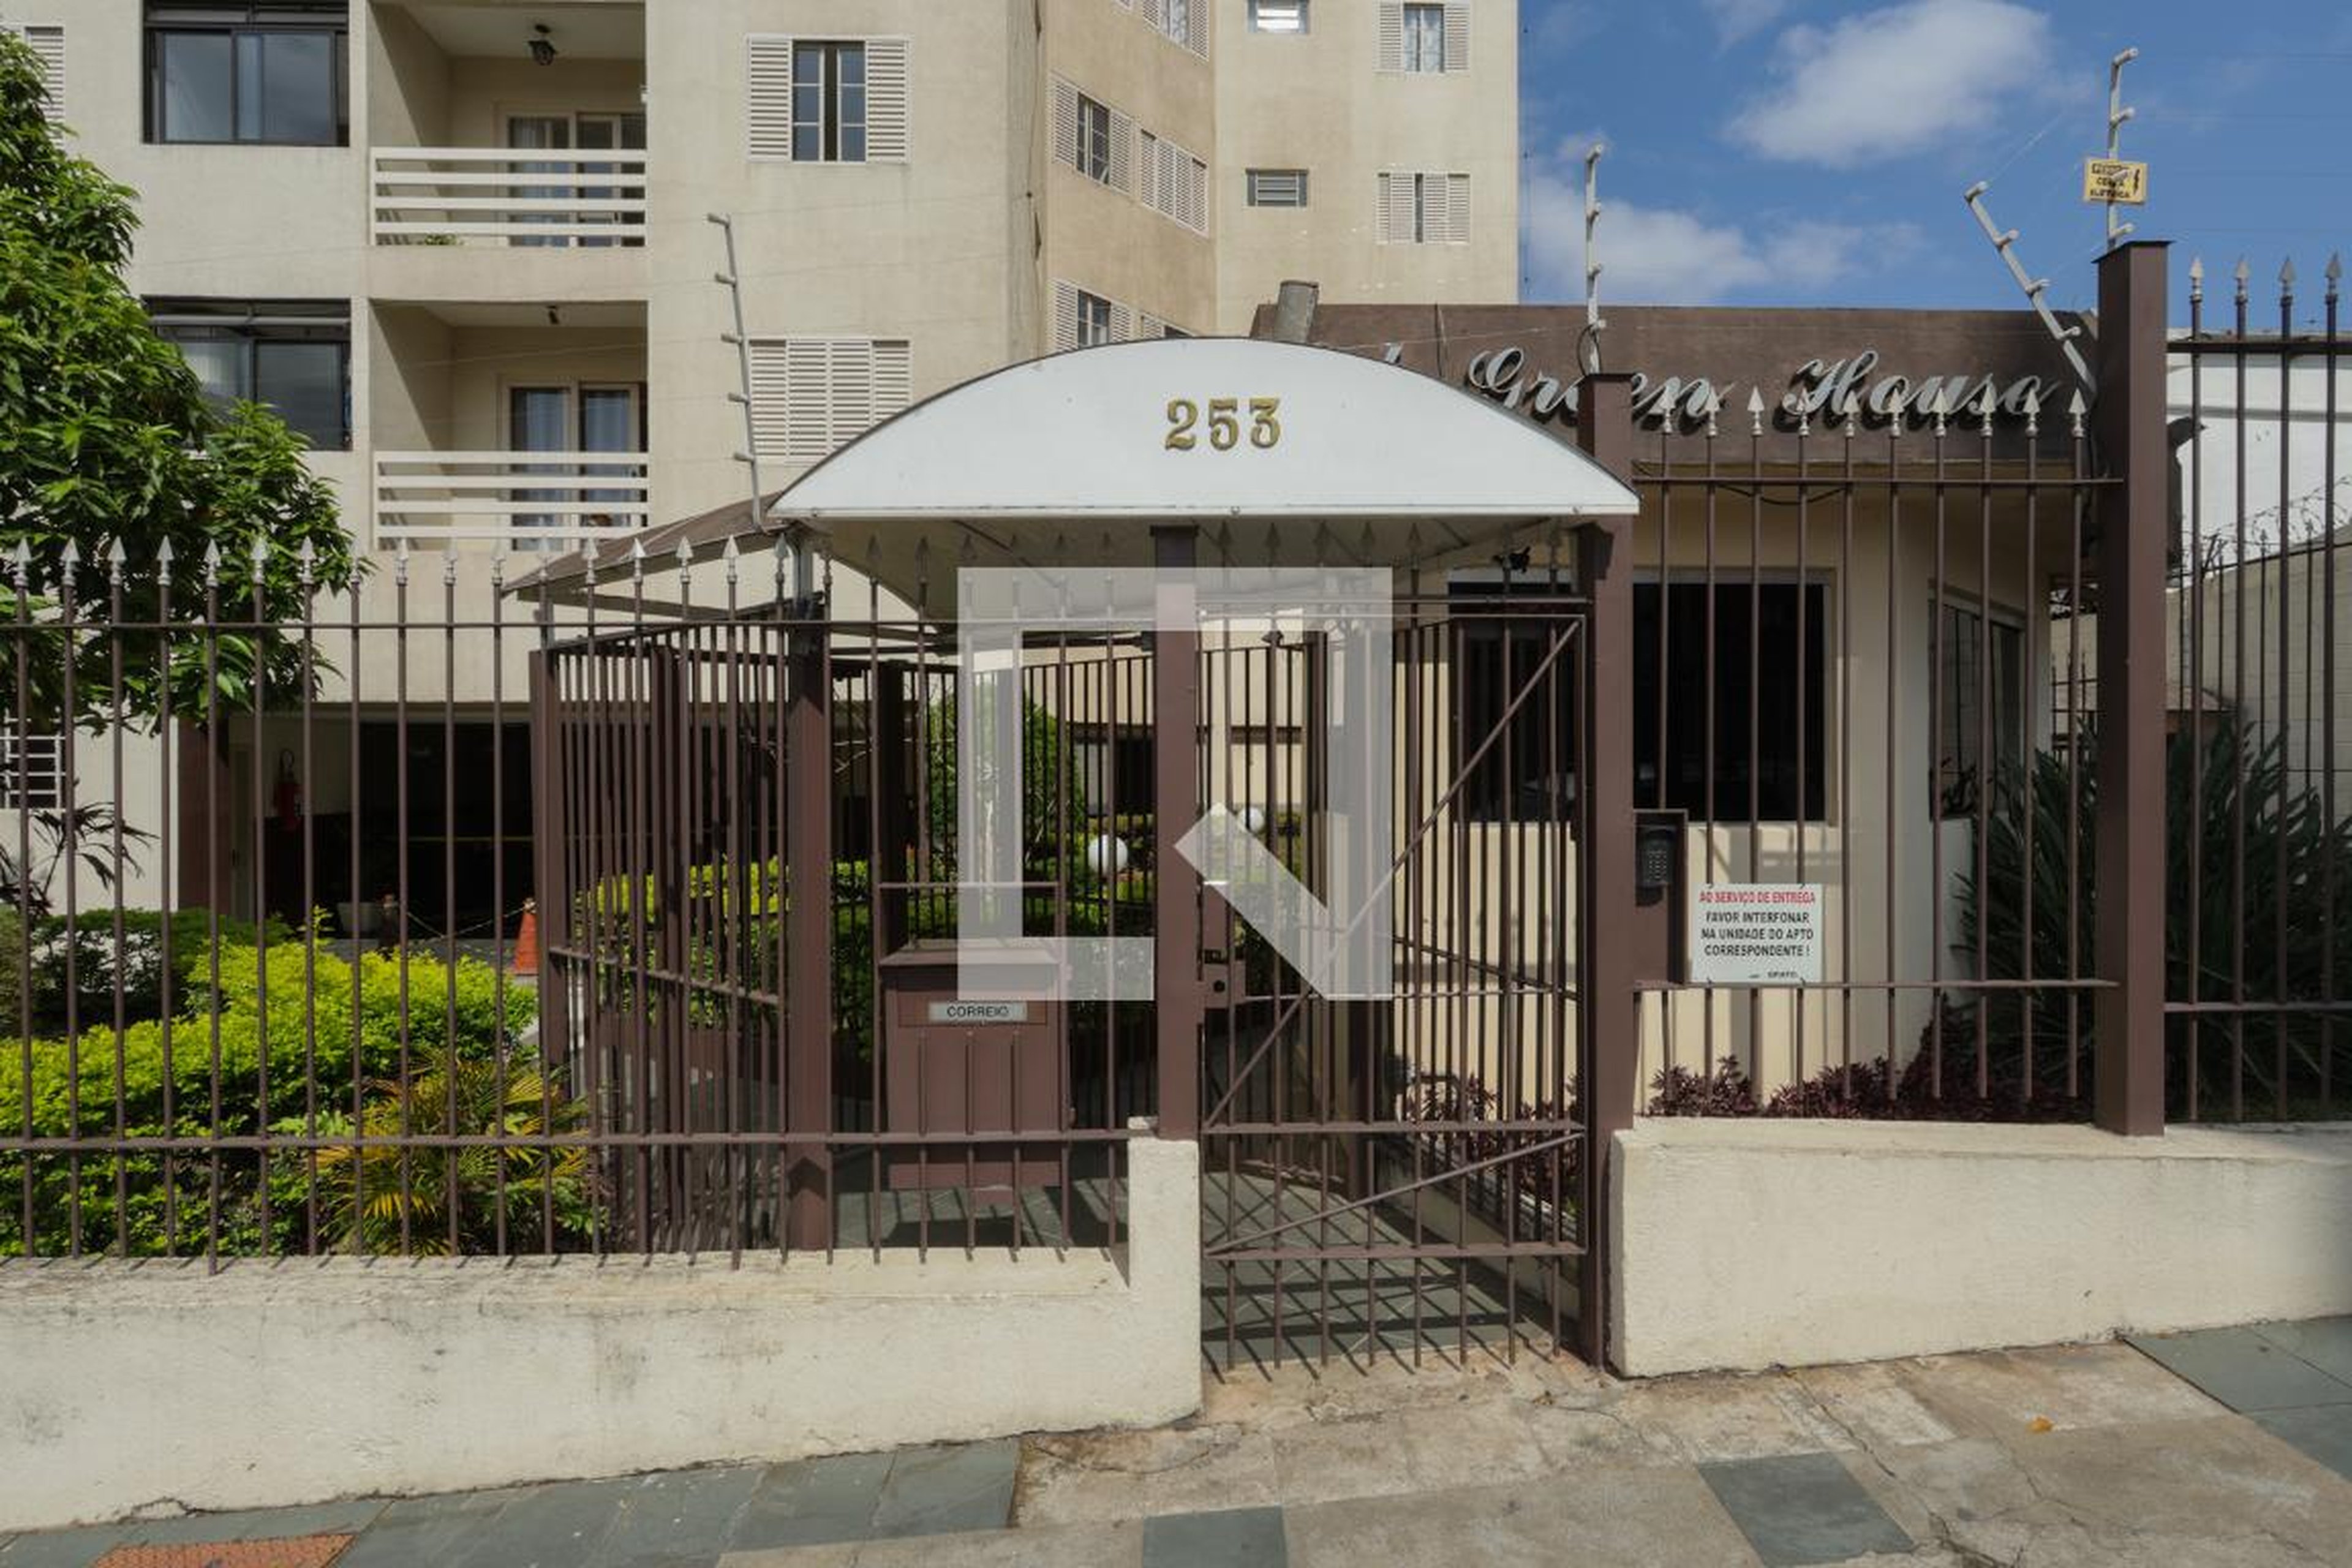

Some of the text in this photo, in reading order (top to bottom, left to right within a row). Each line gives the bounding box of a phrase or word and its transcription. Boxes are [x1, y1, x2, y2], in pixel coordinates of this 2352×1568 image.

[1165, 398, 1281, 451] 253
[1699, 891, 1713, 903] AO
[1757, 891, 1771, 903] DE
[1773, 891, 1815, 903] ENTREGA
[1706, 911, 1810, 923] FAVOR INTERFONAR
[1701, 928, 1814, 940] NA UNIDADE DO APTO
[1704, 944, 1803, 957] CORRESPONDENTE
[946, 1005, 1009, 1017] CORREIO
